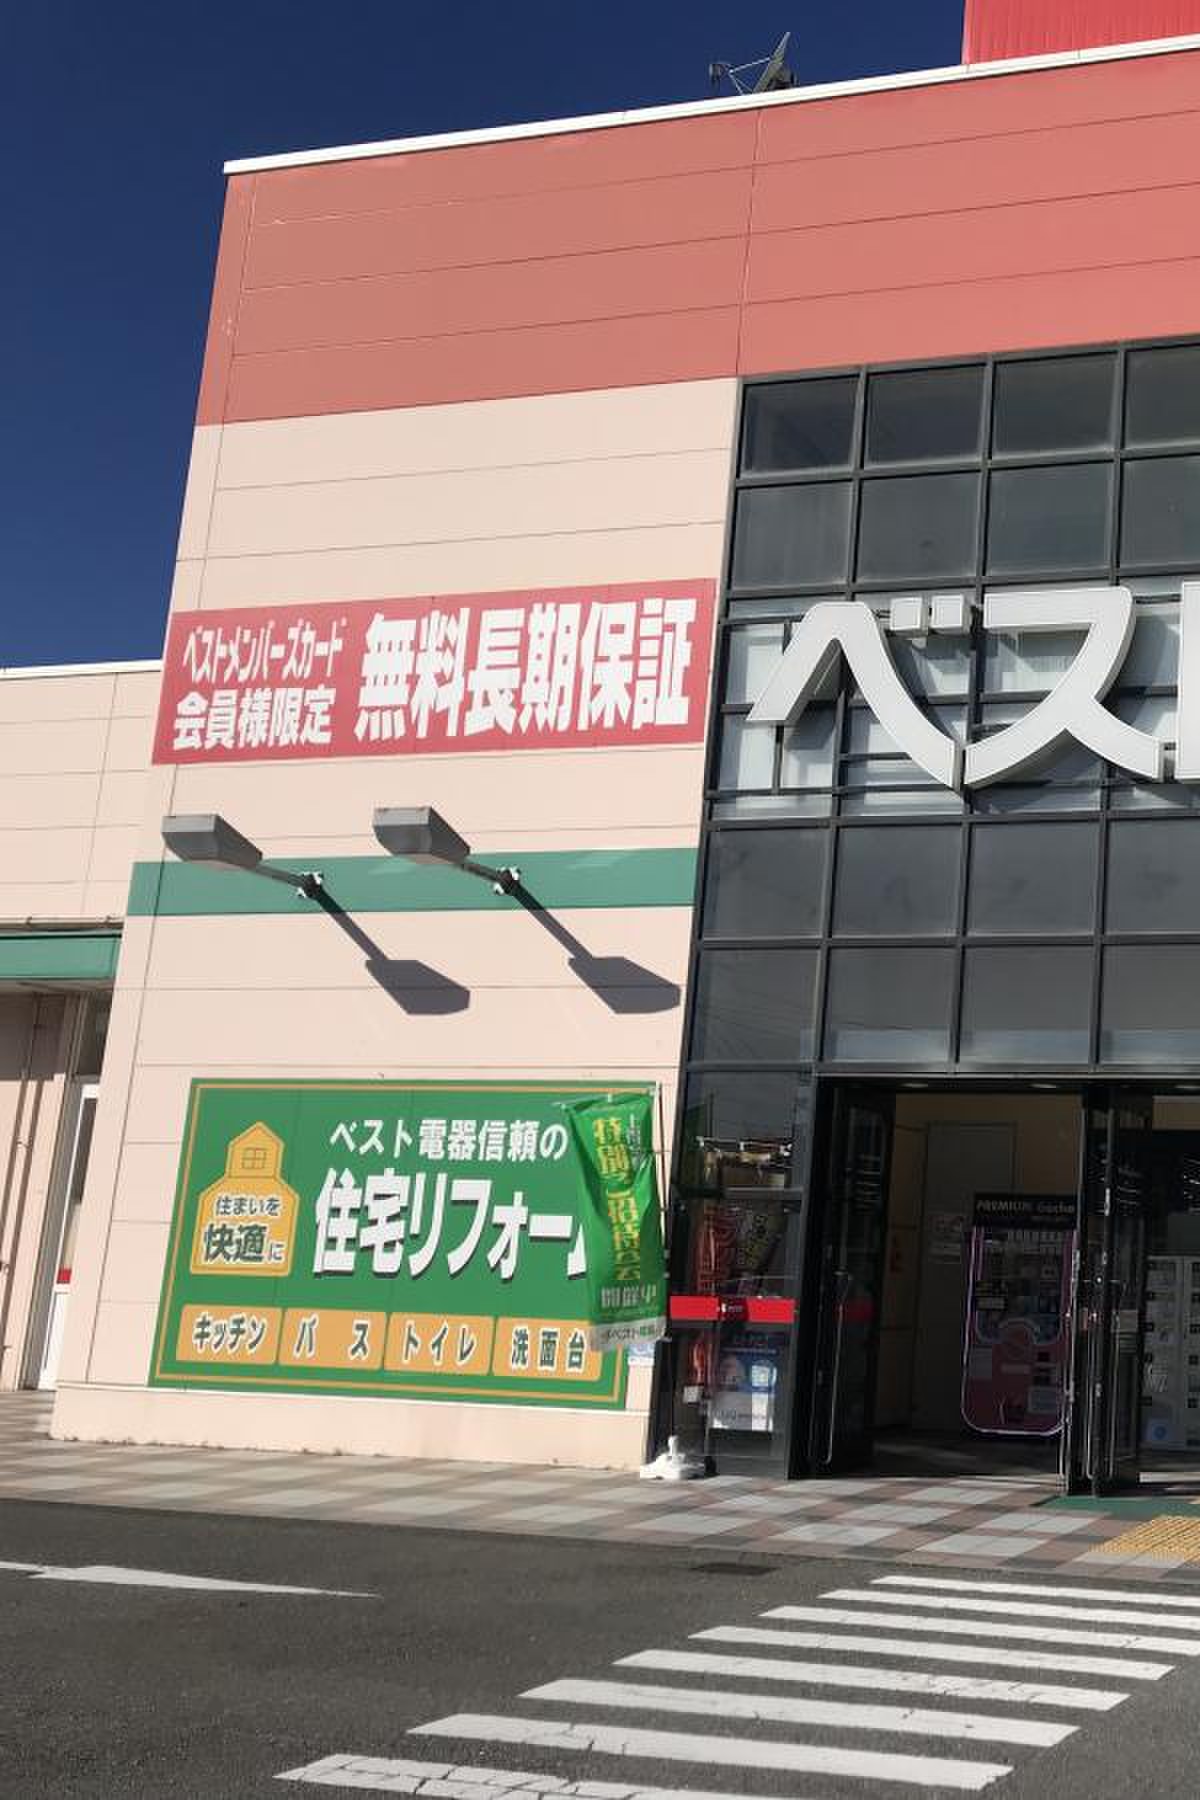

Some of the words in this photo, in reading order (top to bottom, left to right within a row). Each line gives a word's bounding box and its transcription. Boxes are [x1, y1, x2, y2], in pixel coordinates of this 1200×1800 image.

[182, 616, 347, 685] ベストメンバーズカード
[354, 598, 697, 741] 無料長期保証
[172, 685, 336, 751] 会員様限定
[329, 1119, 568, 1162] ベスト電器信頼の
[214, 1194, 281, 1217] 住まいを
[203, 1222, 286, 1263] 快適に
[191, 1311, 268, 1354] キッチン
[401, 1324, 480, 1364] トイレ
[509, 1326, 588, 1371] 洗面台
